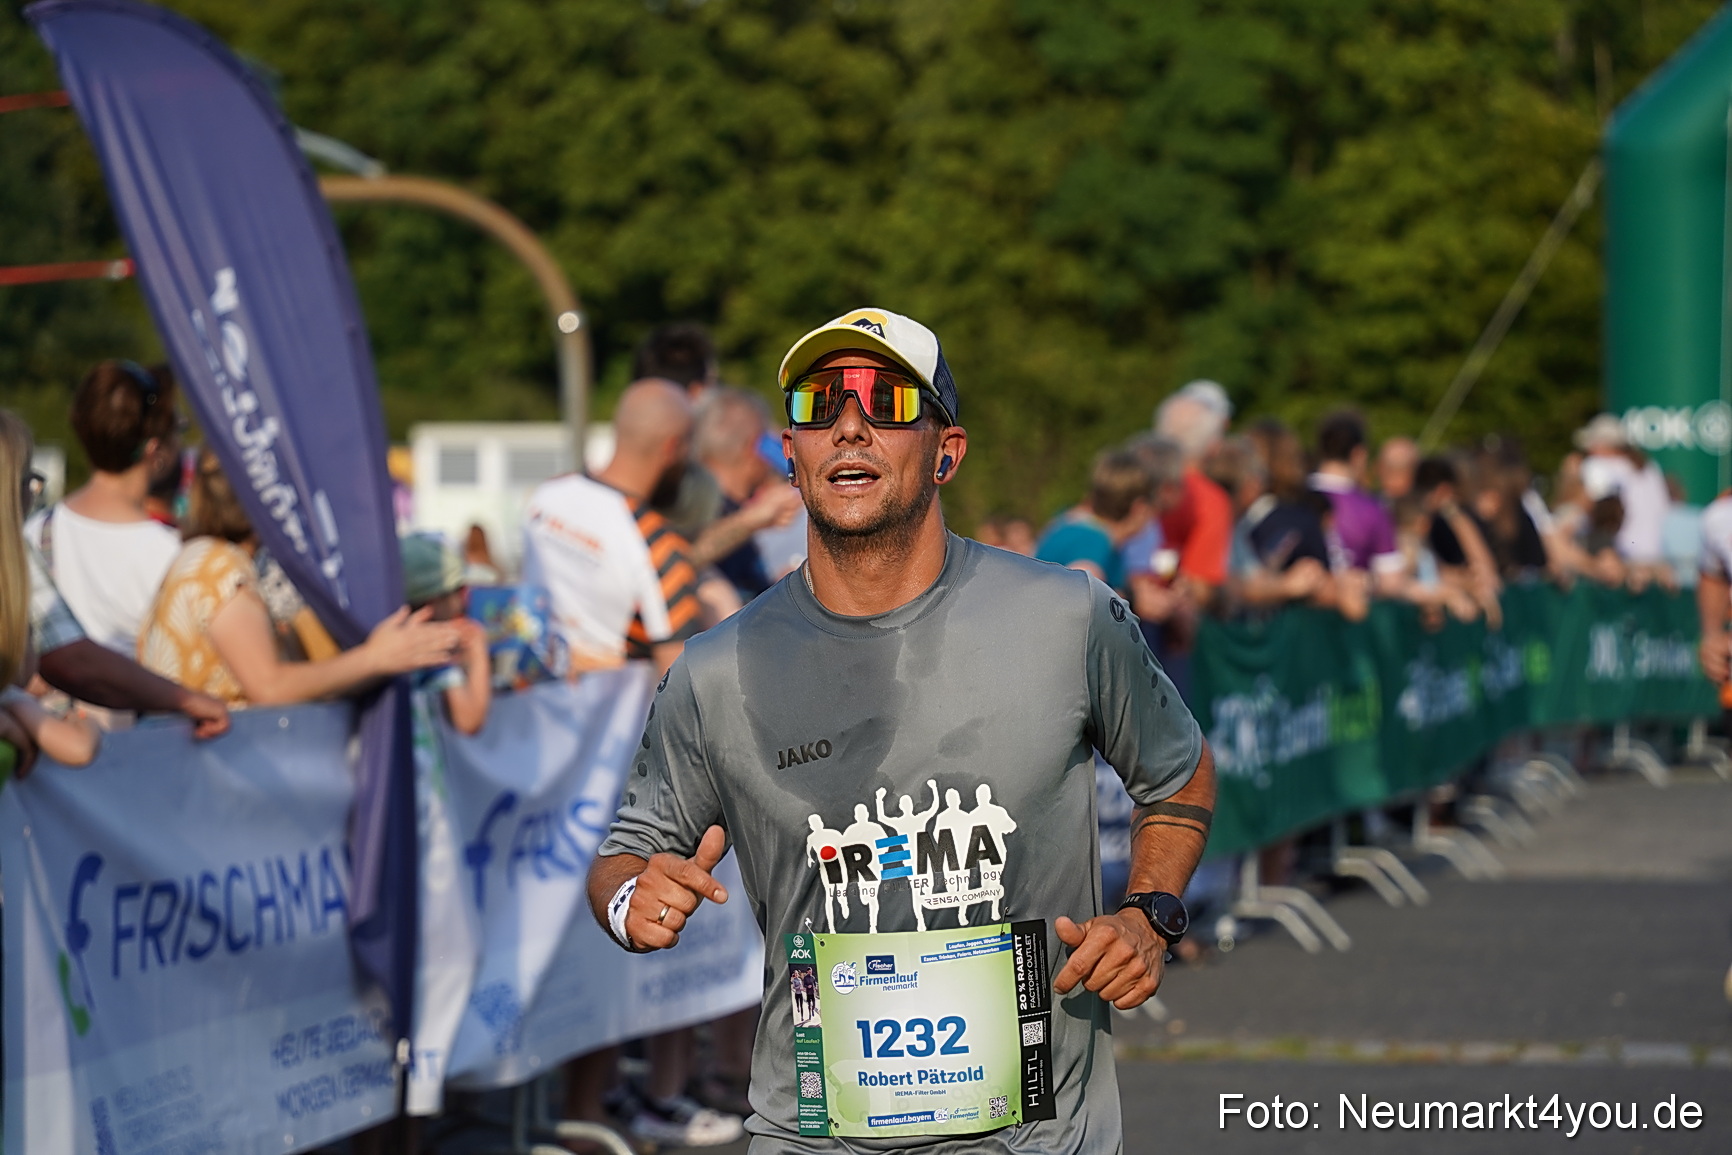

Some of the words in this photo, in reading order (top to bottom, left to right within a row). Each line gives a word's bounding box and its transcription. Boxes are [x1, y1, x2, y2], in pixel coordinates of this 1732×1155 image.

[777, 739, 833, 770] JAKO
[962, 888, 1001, 902] COMPANY
[112, 840, 352, 978] FRISCHMA
[791, 949, 812, 959] AOK
[1015, 934, 1024, 981] RABATT
[1025, 933, 1033, 968] OUTLET
[859, 971, 918, 986] Firmenlauf
[882, 982, 918, 991] neumarkt
[1018, 982, 1026, 992] %
[1027, 969, 1036, 1008] FACTORY
[1020, 993, 1027, 1010] 20
[856, 1016, 969, 1058] 1232
[858, 1070, 913, 1087] Robert
[918, 1066, 984, 1085] Pätzold
[1028, 1050, 1040, 1107] HILTL
[871, 1113, 932, 1126] firmenlauf.bayern
[949, 1111, 980, 1119] Firmenlauf
